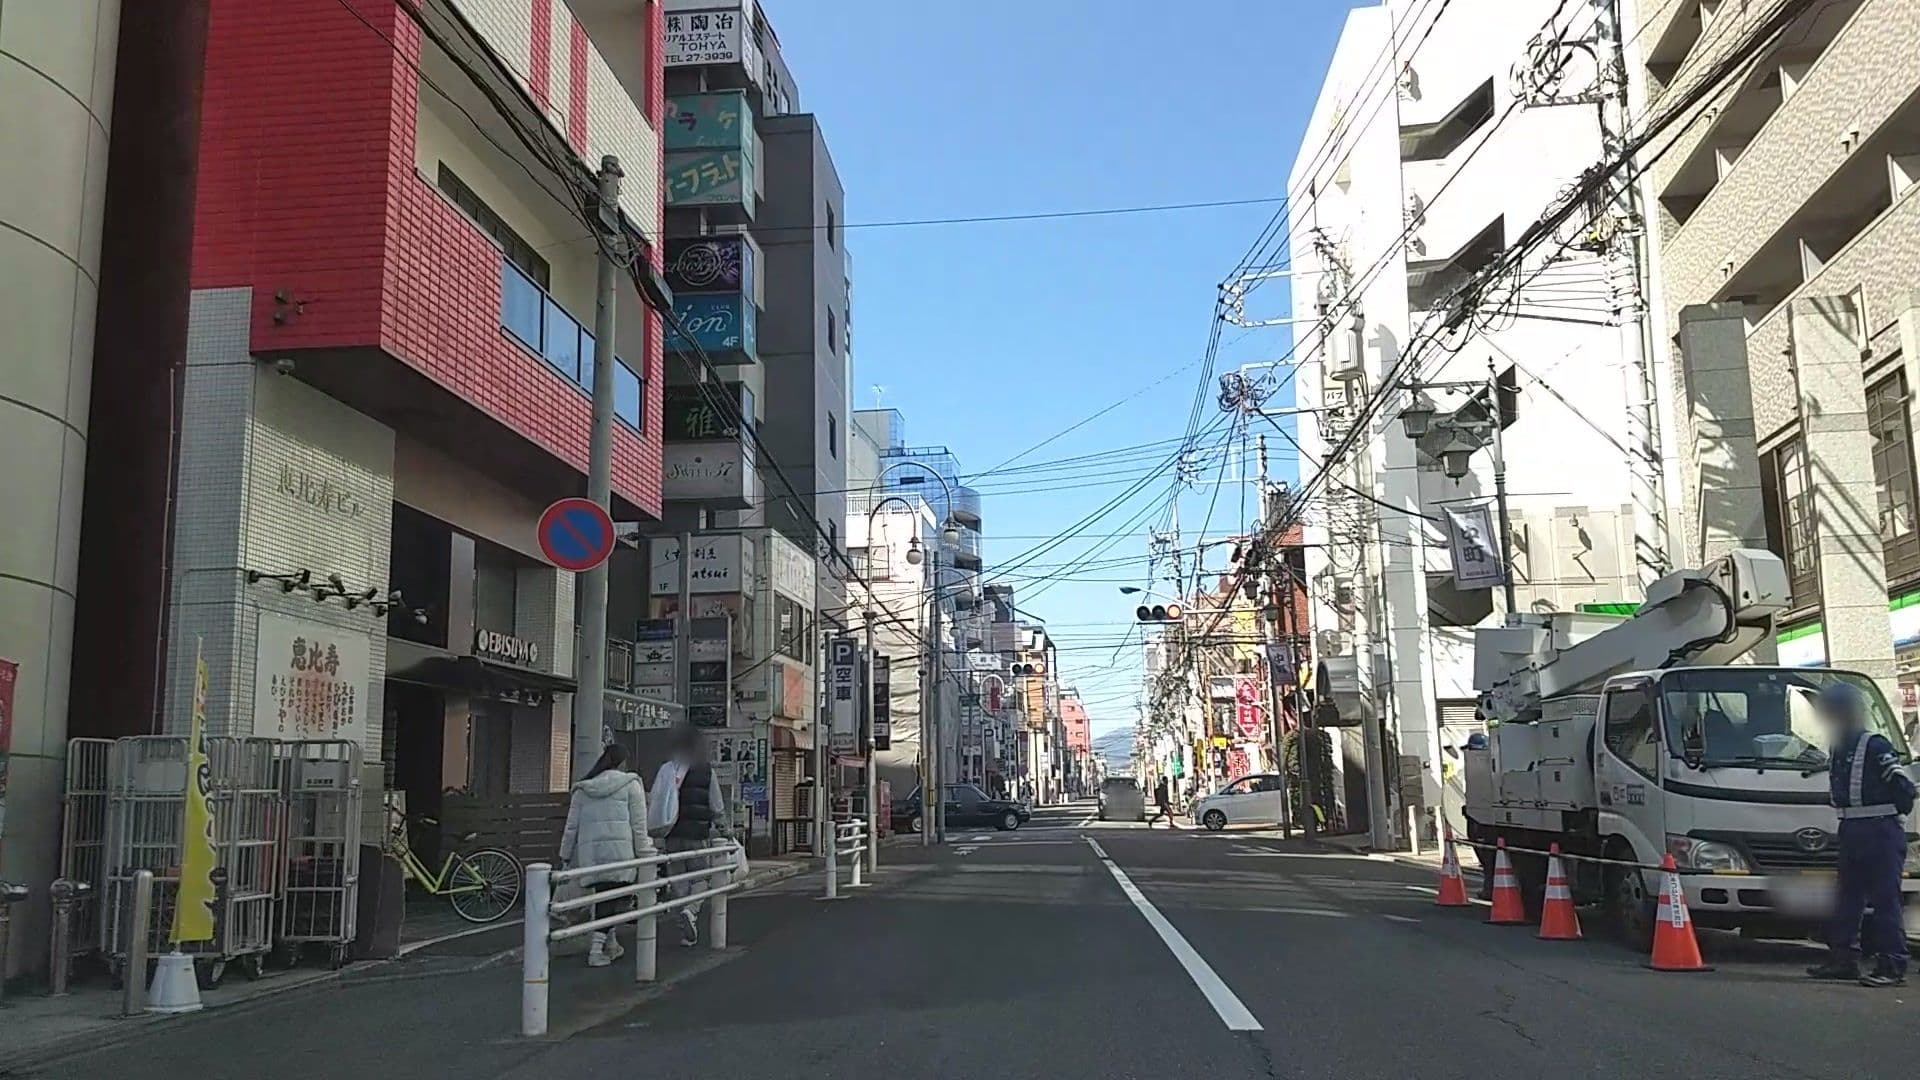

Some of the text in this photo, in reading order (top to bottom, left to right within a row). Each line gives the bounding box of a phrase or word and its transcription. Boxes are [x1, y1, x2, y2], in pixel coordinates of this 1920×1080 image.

[680, 41, 727, 51] TOHYA
[664, 55, 683, 63] TEL
[722, 336, 739, 347] 4F
[687, 404, 716, 438] 雅
[489, 631, 529, 661] EBISUYA
[836, 645, 851, 663] P
[835, 667, 852, 701] 空車
